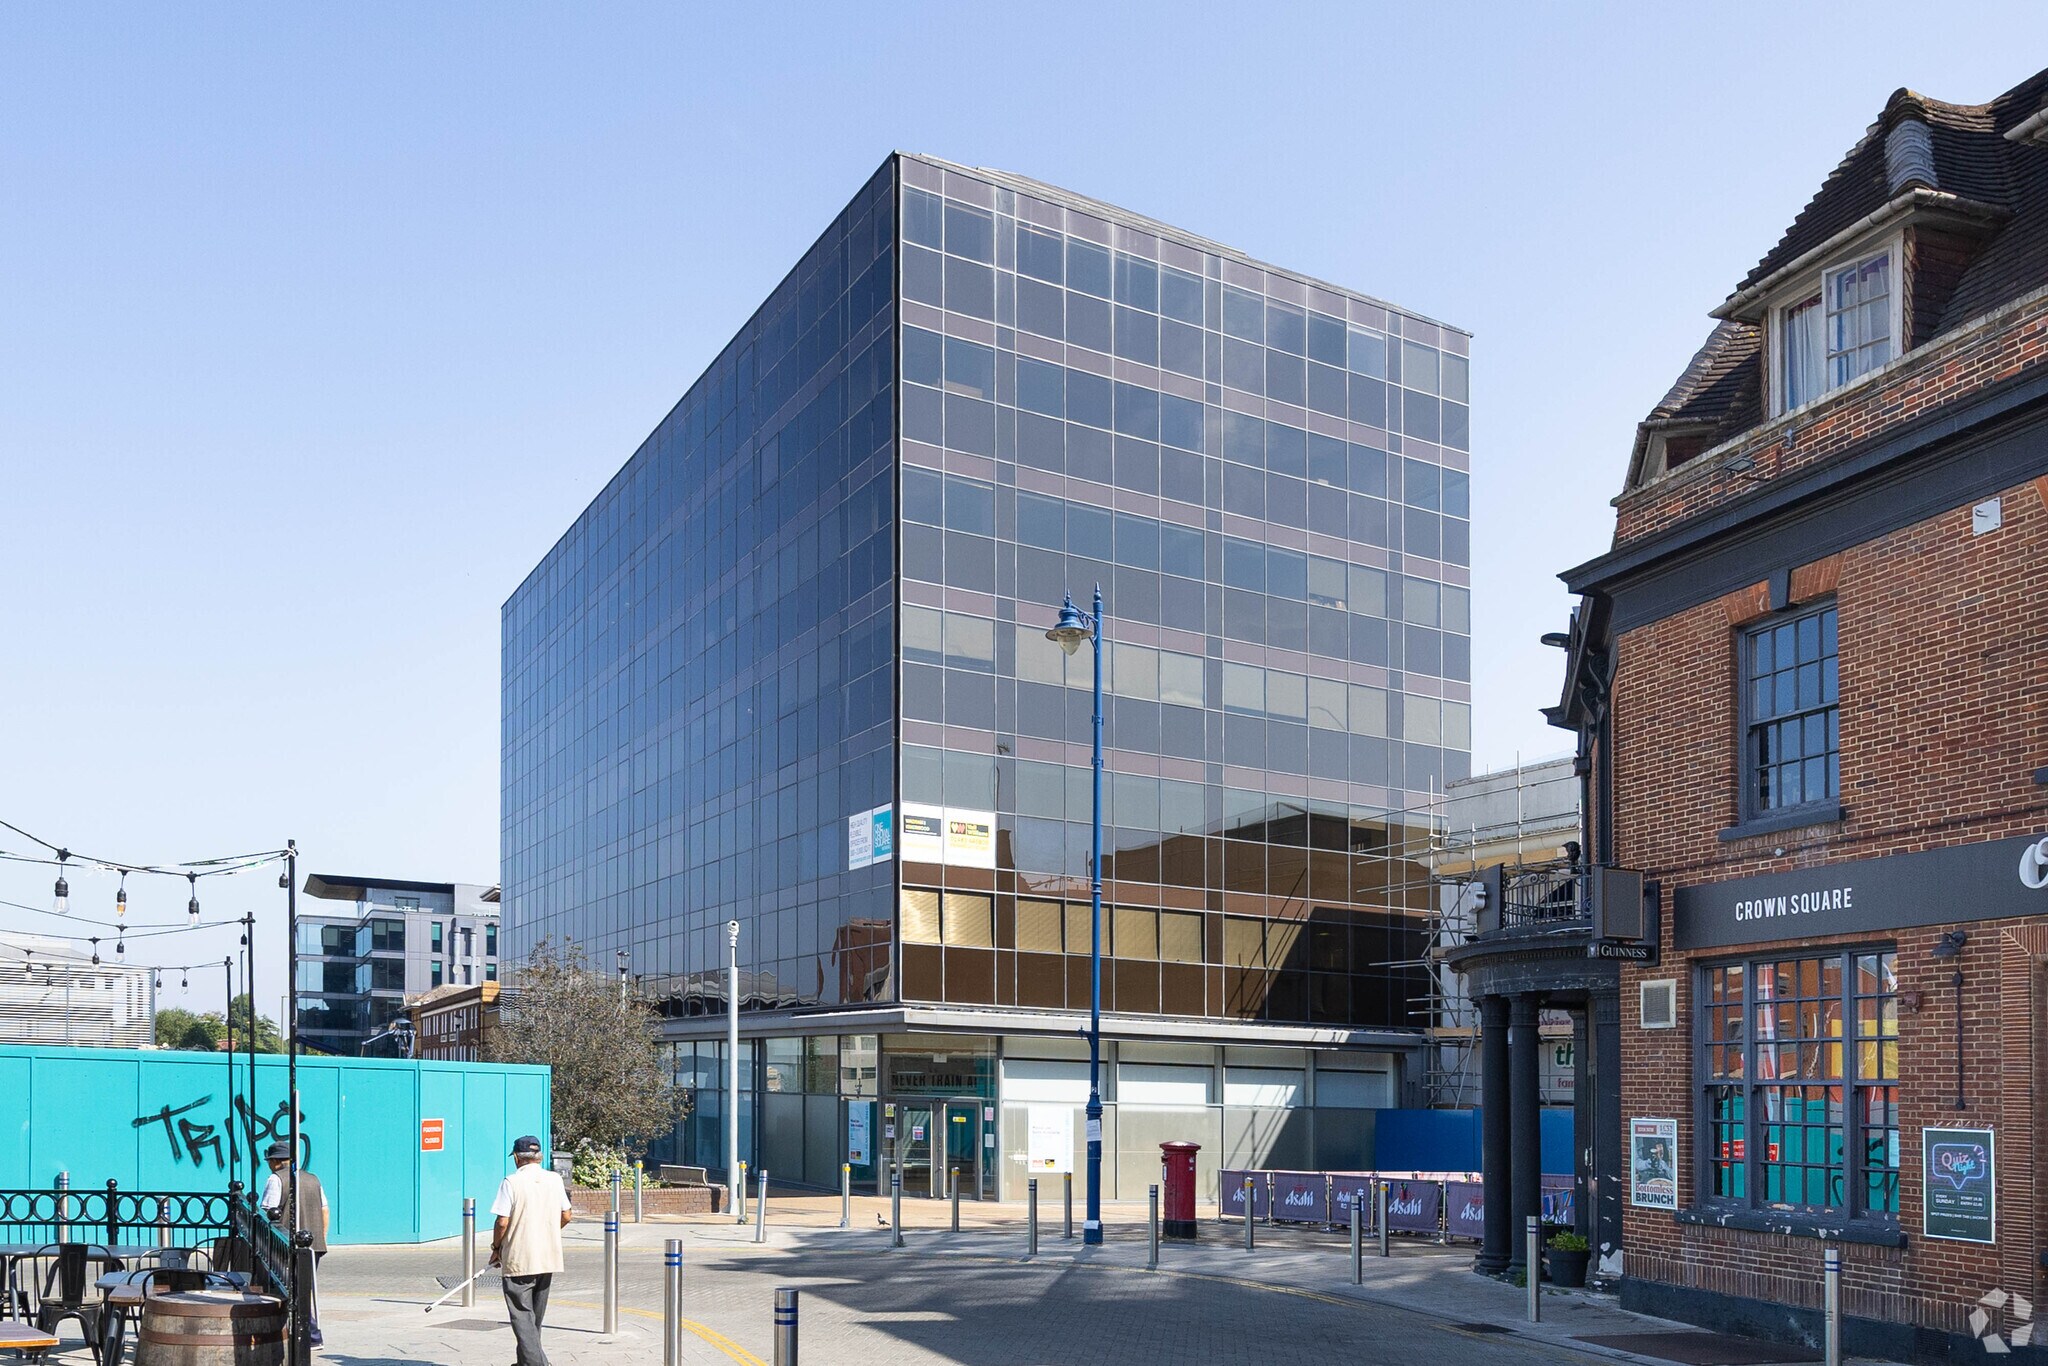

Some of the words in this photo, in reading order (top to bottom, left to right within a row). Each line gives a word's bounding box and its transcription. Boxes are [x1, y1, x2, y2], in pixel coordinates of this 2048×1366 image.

[1735, 897, 1787, 921] CROWN
[1790, 887, 1853, 915] SQUARE
[1601, 944, 1647, 958] GUINNESS
[891, 1074, 926, 1087] NEVER
[931, 1074, 962, 1087] TRAIN
[1941, 1152, 1969, 1171] Quiz
[1635, 1183, 1674, 1195] Bottomless
[1285, 1189, 1314, 1207] Asahi
[1635, 1193, 1674, 1205] BRUNCH
[1388, 1197, 1422, 1216] Asahi
